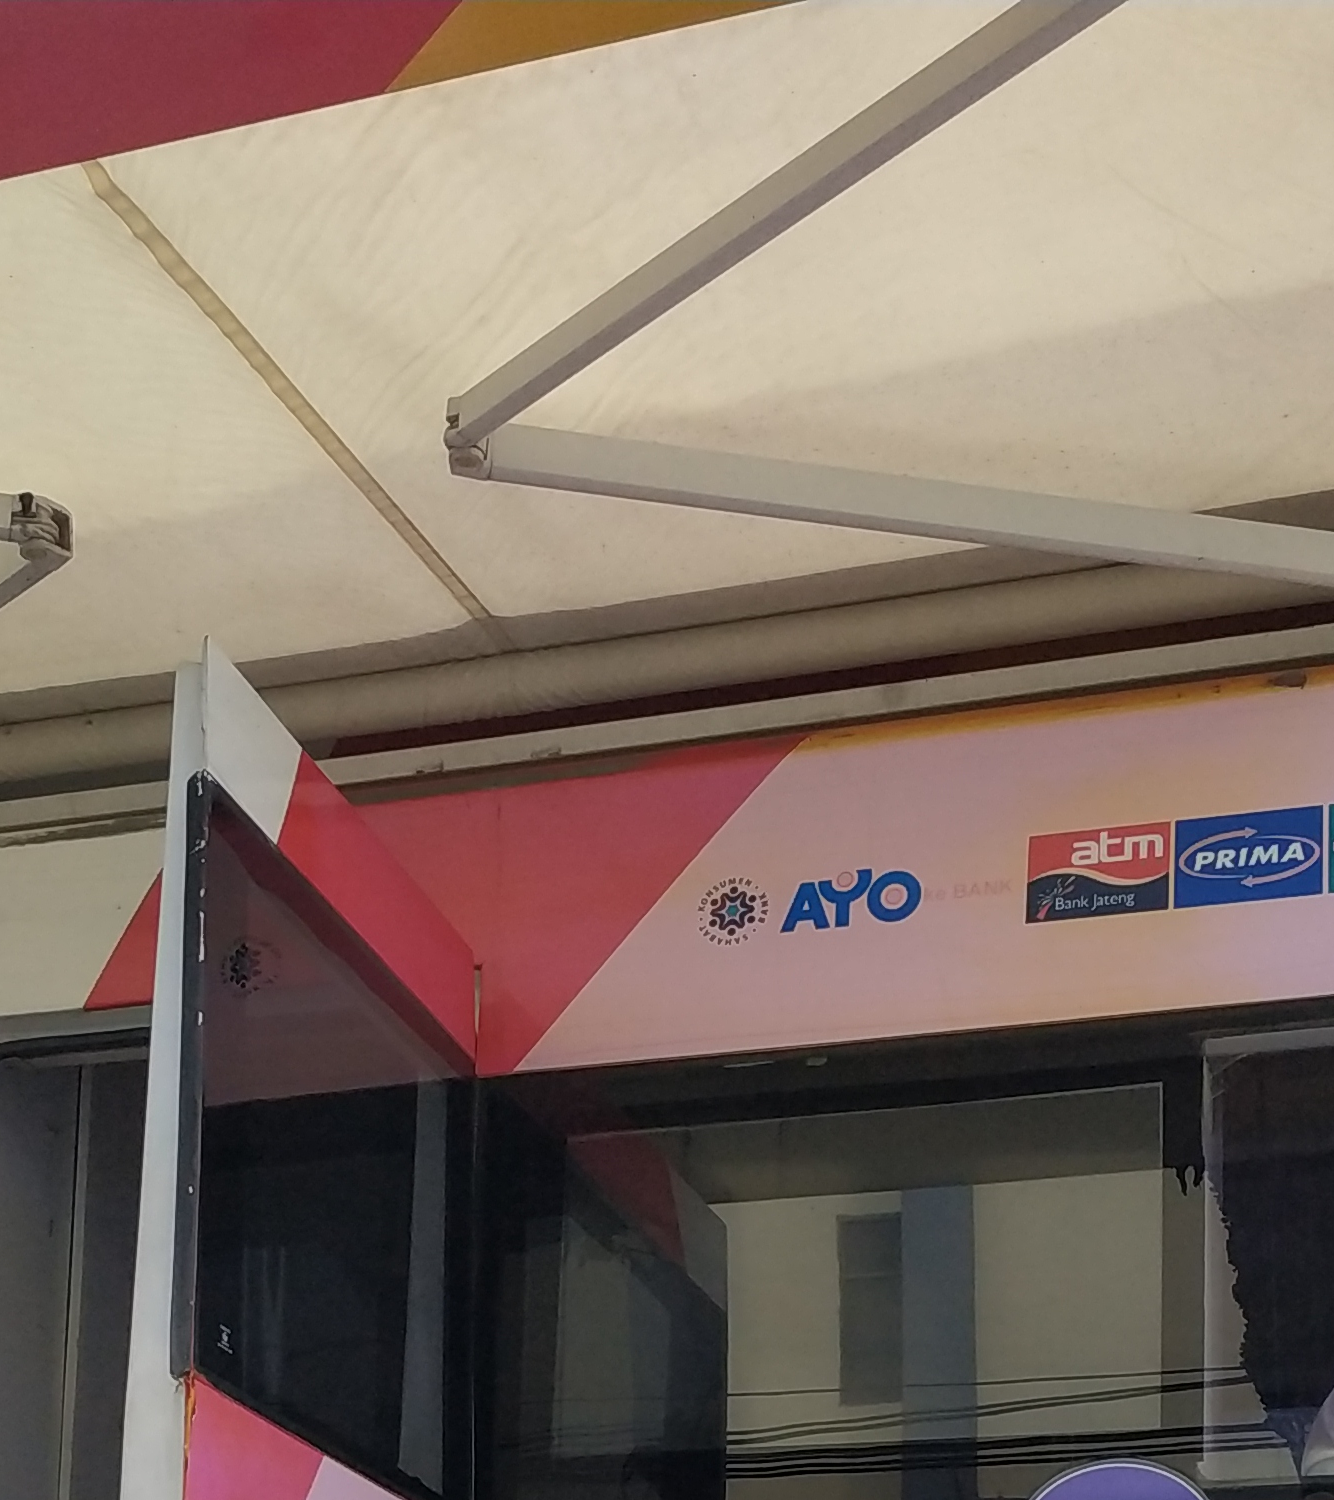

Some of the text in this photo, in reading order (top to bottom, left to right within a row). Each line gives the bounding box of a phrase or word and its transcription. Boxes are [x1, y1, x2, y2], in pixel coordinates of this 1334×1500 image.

[1071, 831, 1164, 866] atm
[1194, 842, 1306, 871] PRIMA
[697, 877, 753, 912] KONSUMEN
[780, 868, 923, 934] AYO
[1054, 892, 1136, 912] Bank Jateng
